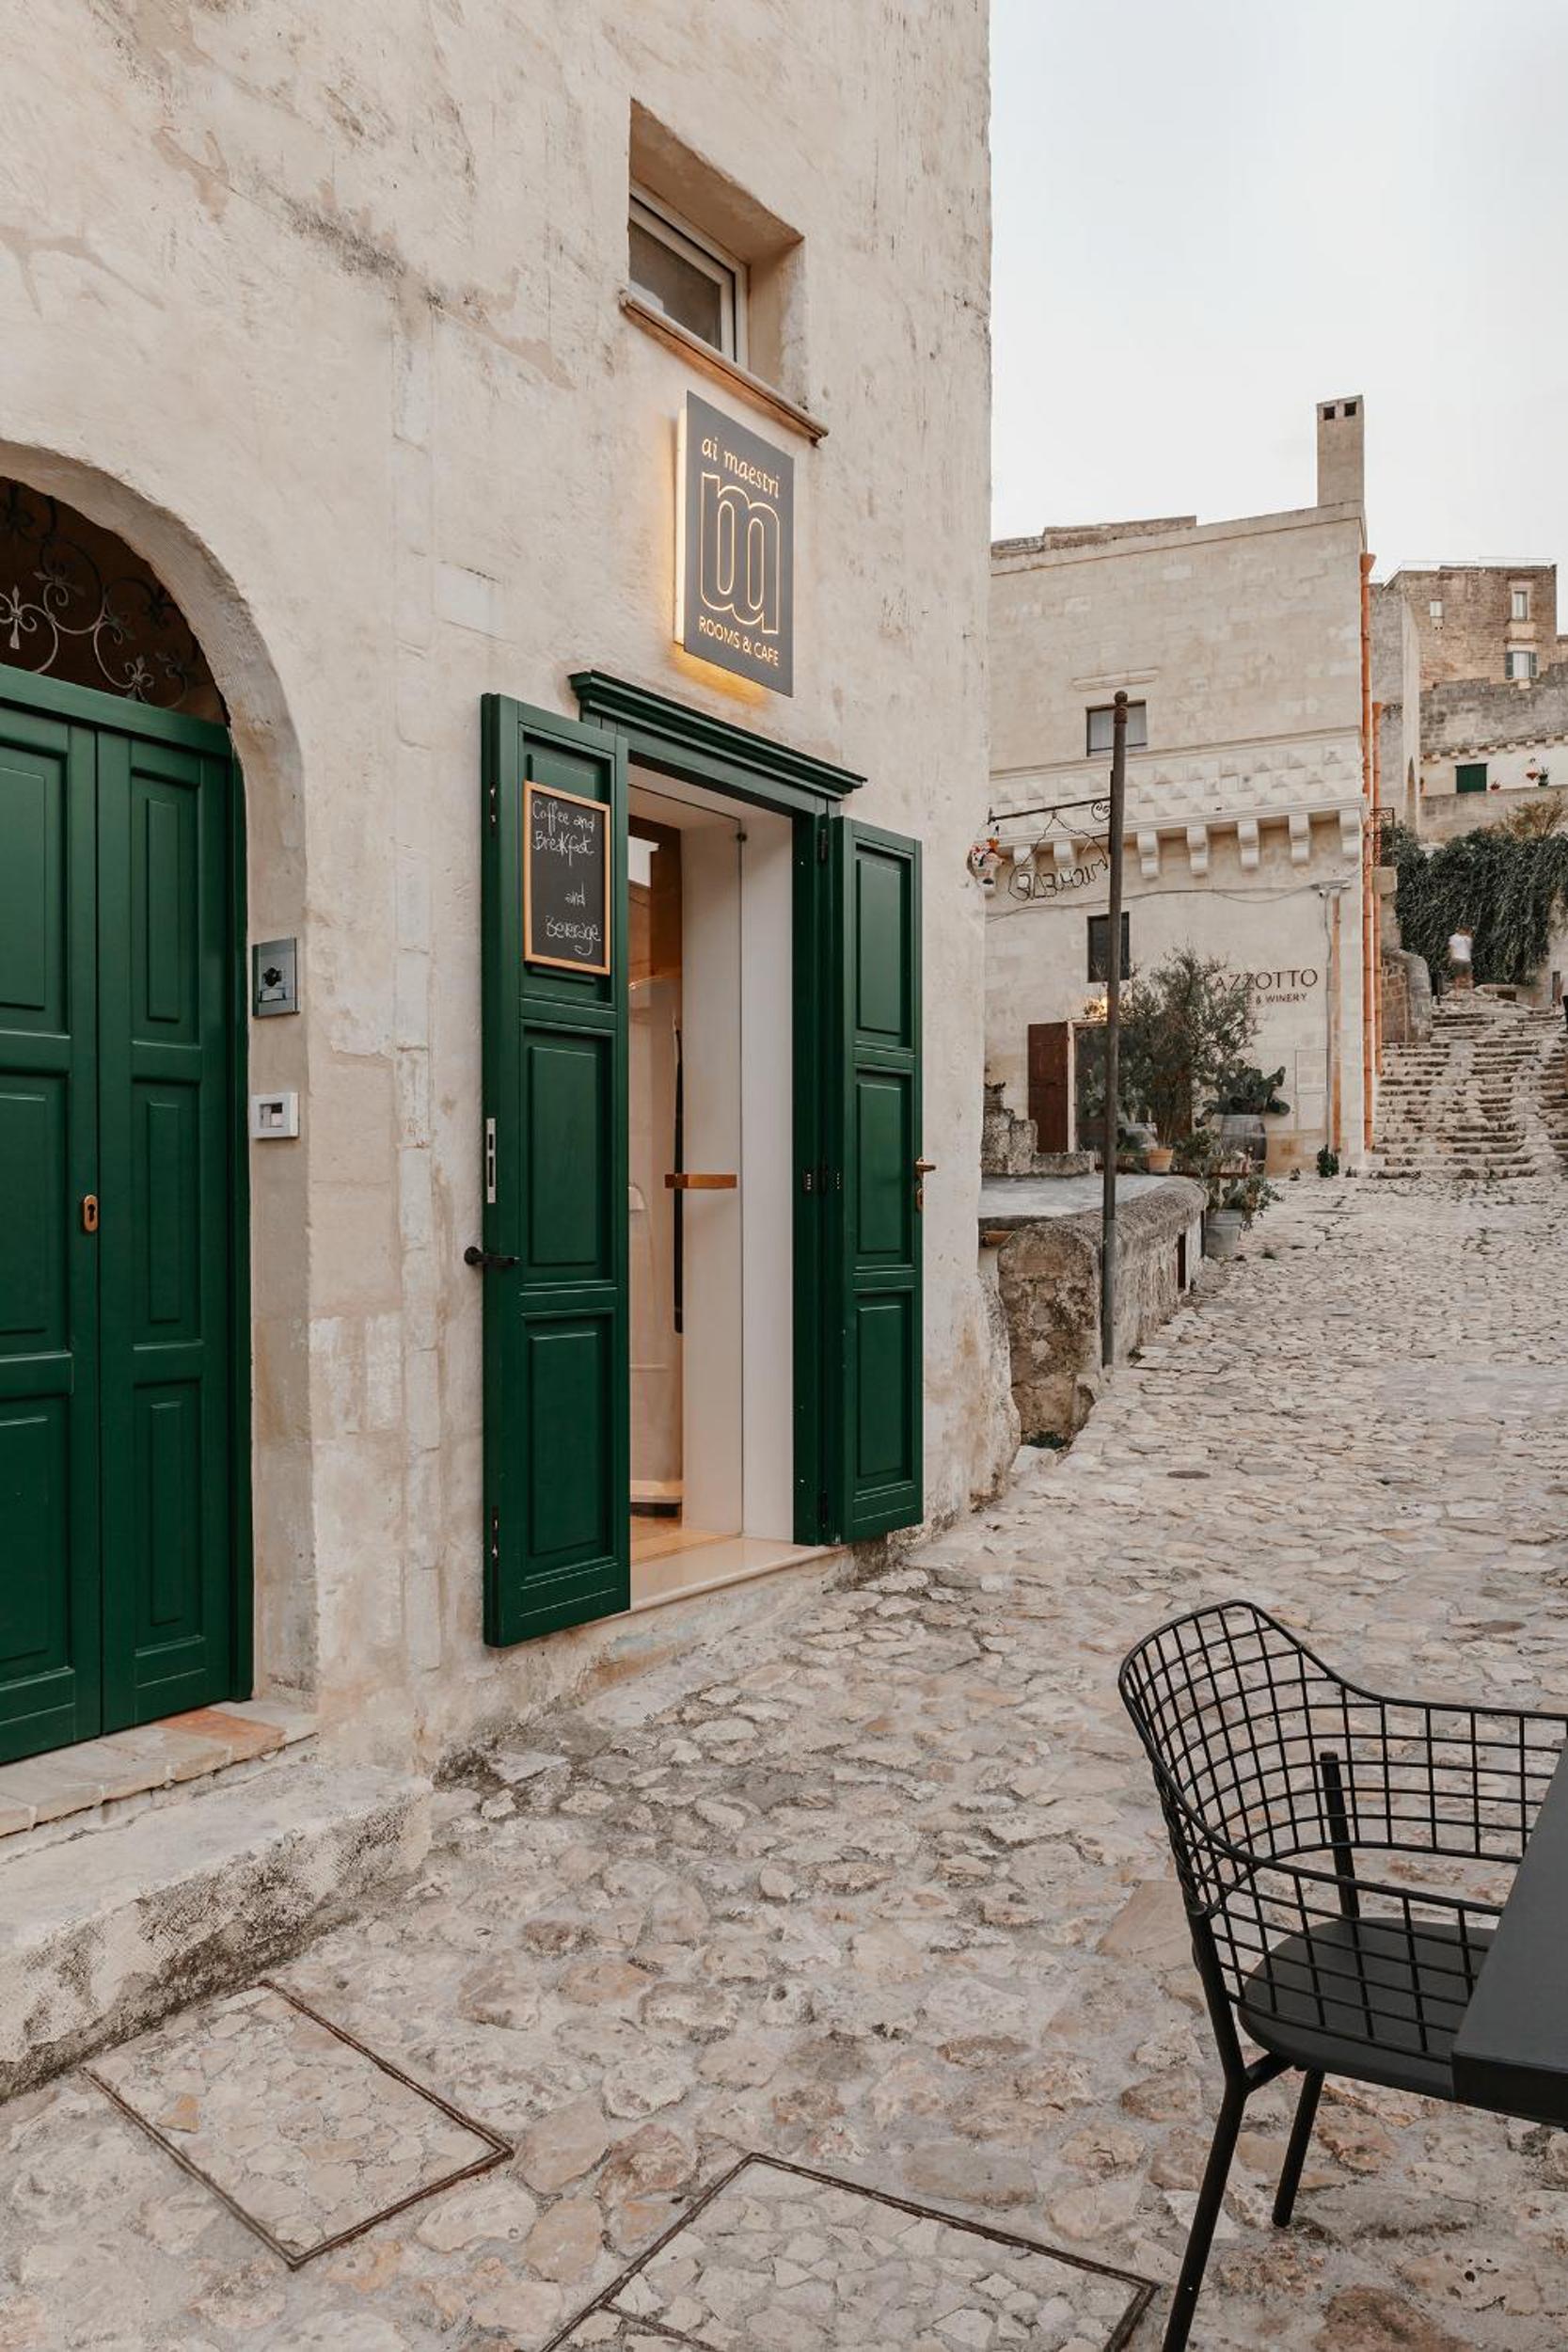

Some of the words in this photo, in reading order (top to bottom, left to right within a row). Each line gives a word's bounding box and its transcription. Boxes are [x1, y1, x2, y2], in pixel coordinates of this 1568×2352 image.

[701, 436, 719, 461] ai
[723, 450, 780, 499] maestri
[699, 614, 740, 650] ROOMS
[742, 635, 753, 656] &
[532, 799, 570, 837] Coffee
[573, 813, 596, 834] and
[564, 881, 587, 909] and
[1213, 968, 1318, 993] AZZOTTO
[1265, 992, 1308, 1004] WINERY
